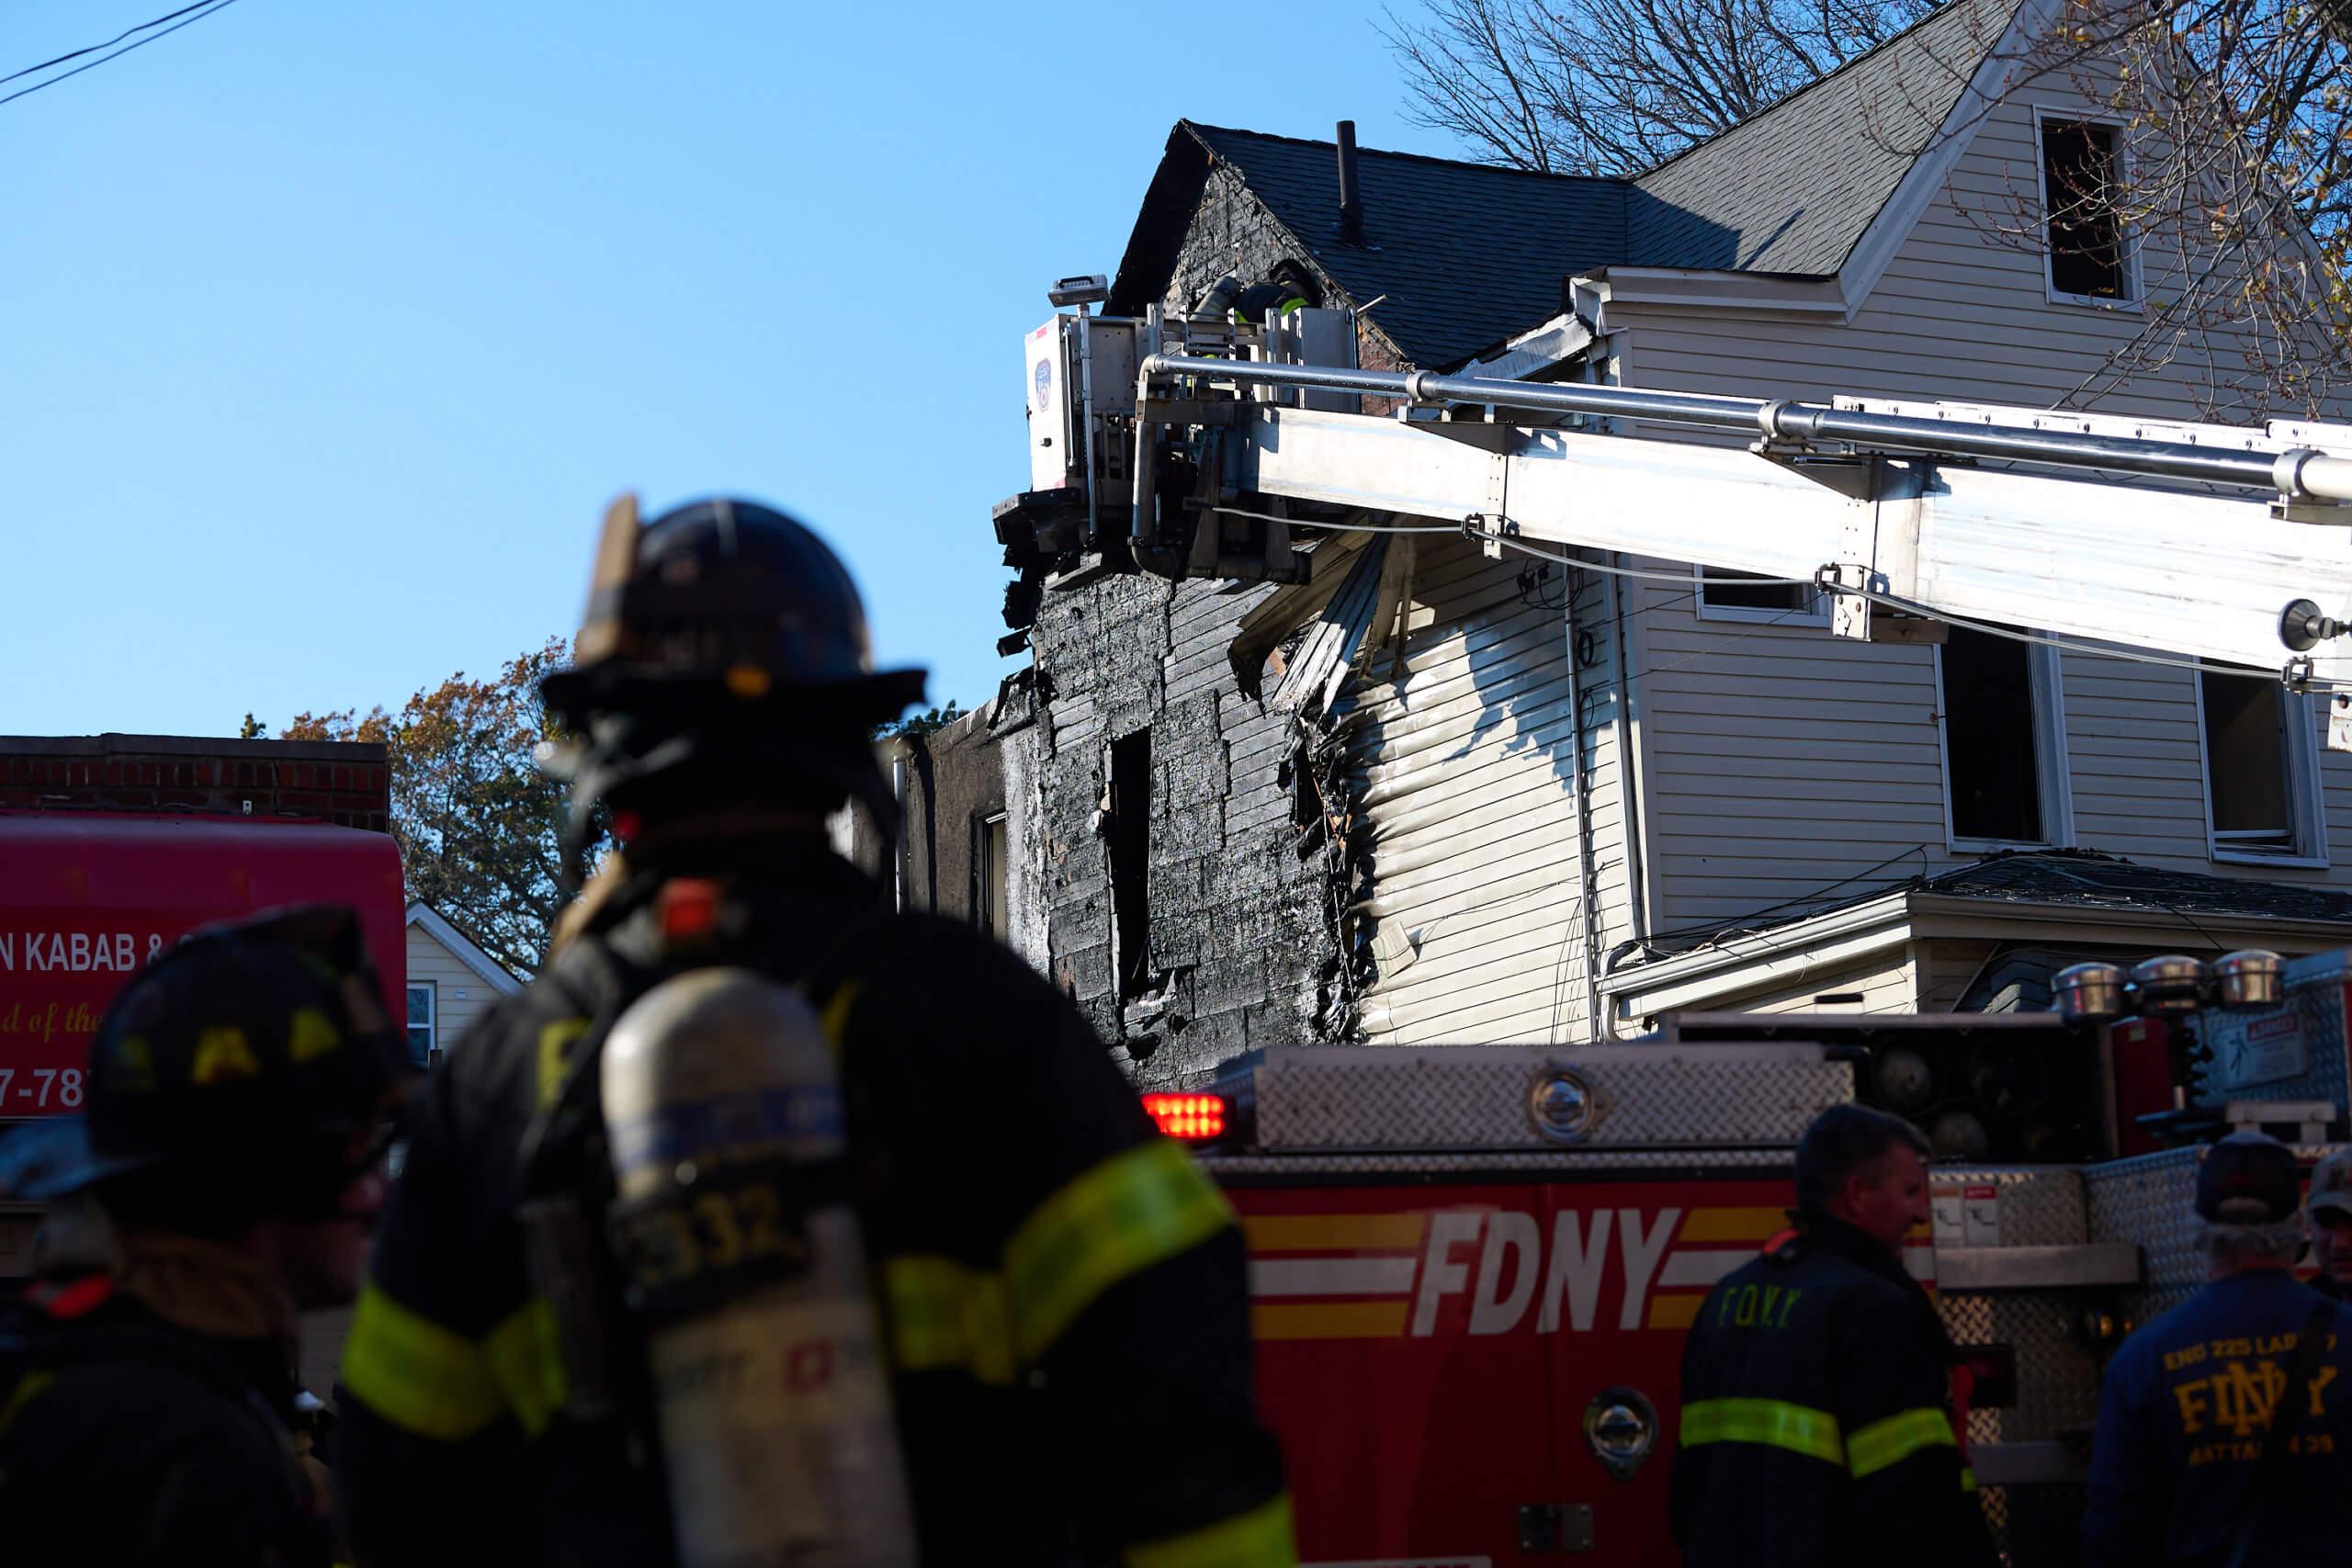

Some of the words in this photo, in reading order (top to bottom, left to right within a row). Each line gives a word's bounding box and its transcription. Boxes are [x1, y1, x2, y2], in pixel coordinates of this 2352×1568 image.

[25, 932, 137, 972] KABAB
[28, 1002, 59, 1043] of
[64, 1002, 103, 1033] the
[0, 1067, 91, 1108] 7-78
[1411, 1206, 1684, 1337] FDNY
[2164, 1343, 2207, 1371] ENG
[2210, 1337, 2251, 1359] 225
